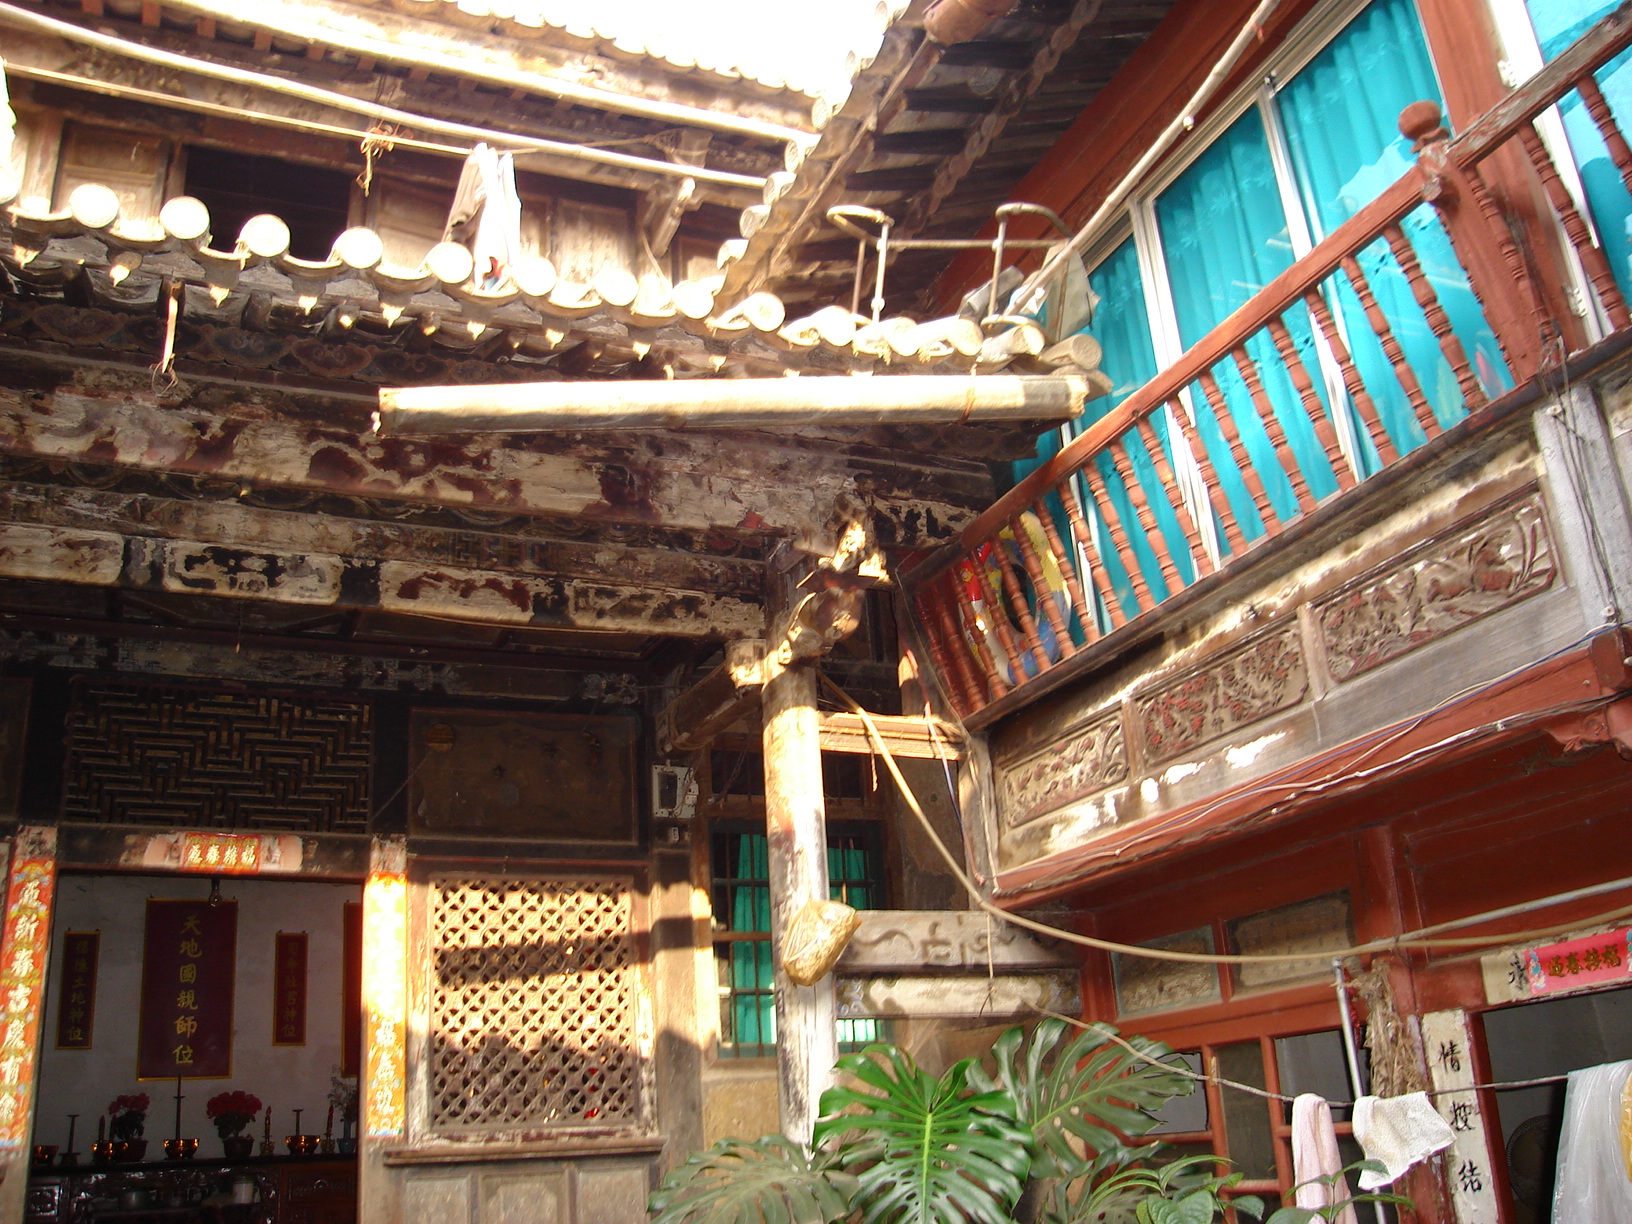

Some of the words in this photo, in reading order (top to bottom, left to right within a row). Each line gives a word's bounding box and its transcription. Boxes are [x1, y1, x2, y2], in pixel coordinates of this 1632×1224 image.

[171, 915, 204, 1065] 天地國親師位
